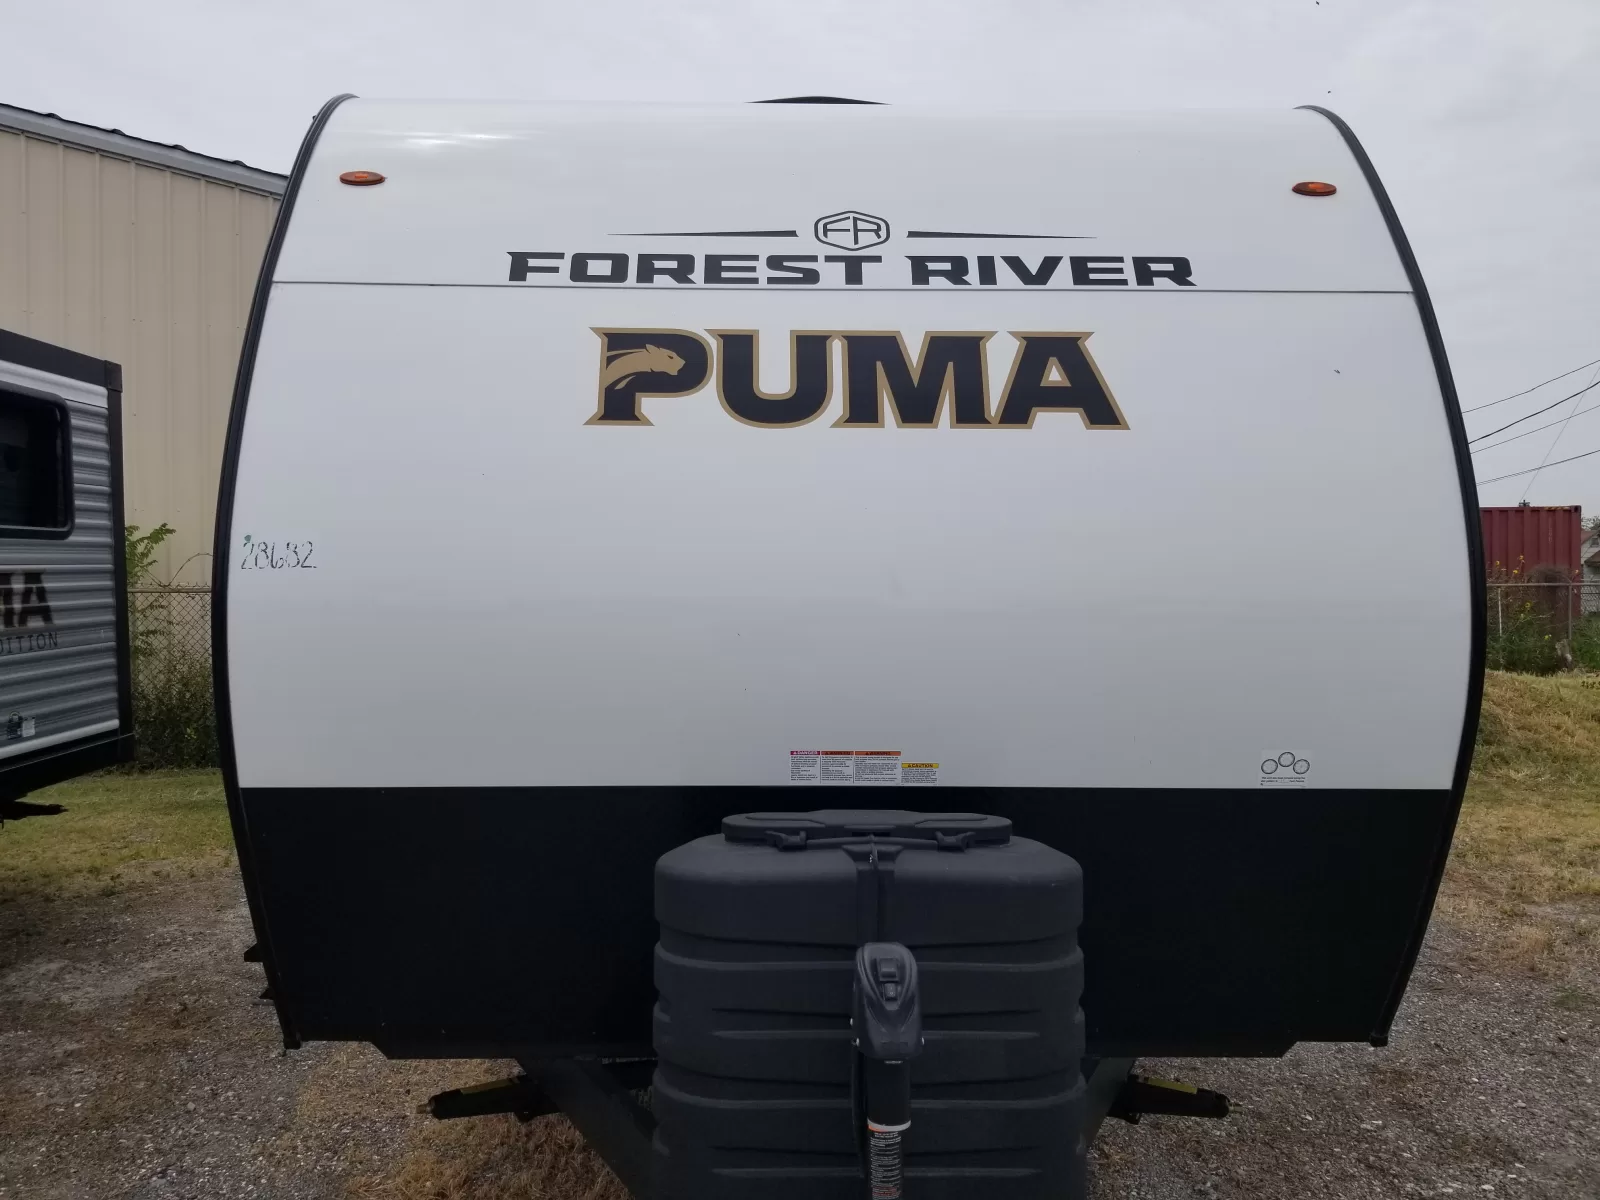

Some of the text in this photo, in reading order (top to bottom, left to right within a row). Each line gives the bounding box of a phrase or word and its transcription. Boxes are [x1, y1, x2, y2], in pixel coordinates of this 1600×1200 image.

[507, 251, 1197, 286] FOREST RIVER
[583, 326, 1131, 430] PUMA
